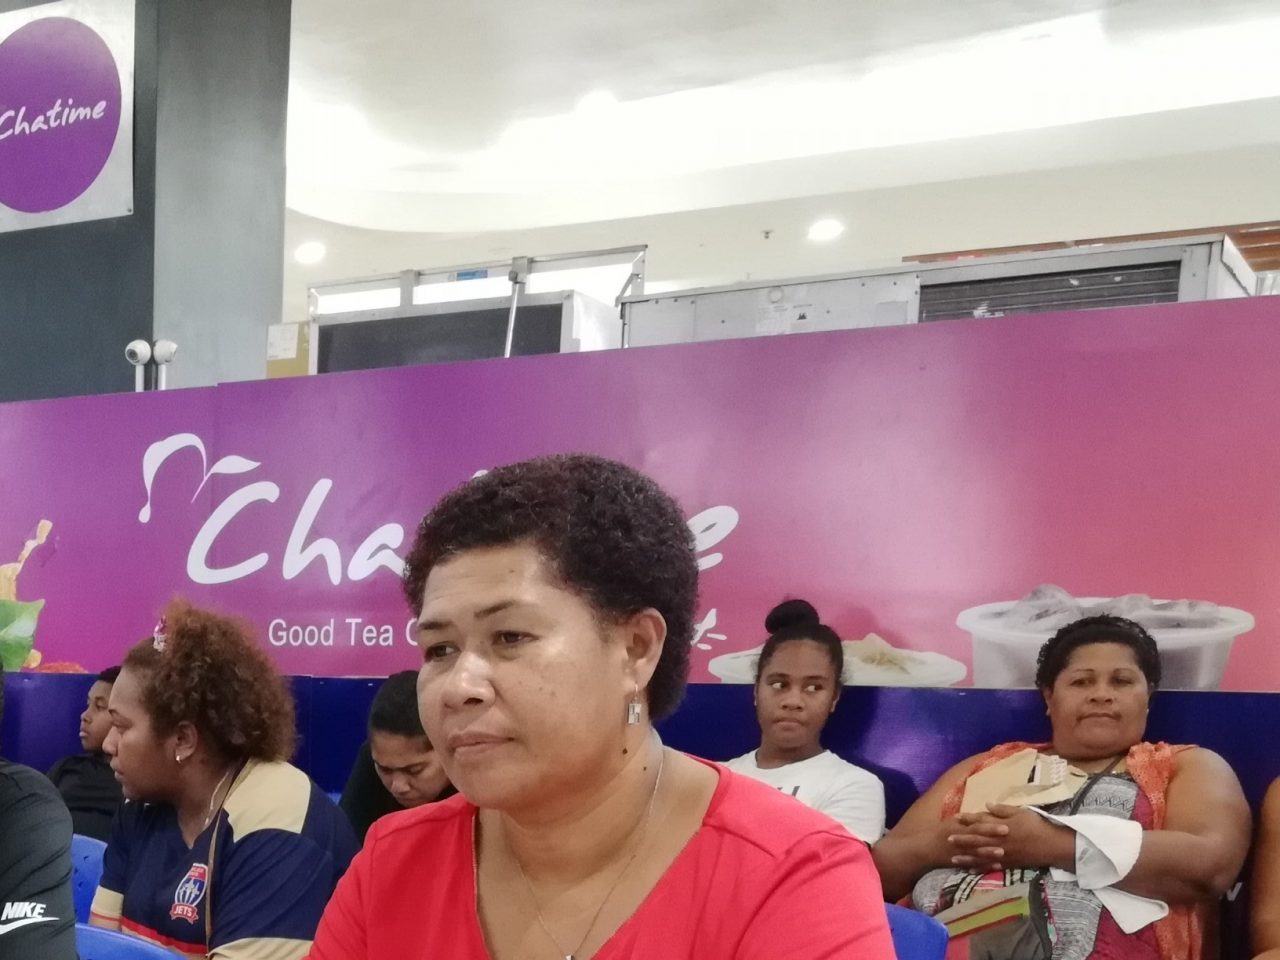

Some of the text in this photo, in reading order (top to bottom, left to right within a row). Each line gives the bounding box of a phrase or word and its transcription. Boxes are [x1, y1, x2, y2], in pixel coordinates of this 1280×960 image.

[268, 618, 335, 647] Good
[345, 618, 394, 647] Tea
[1, 902, 46, 920] NIKE
[173, 905, 193, 917] JETS
